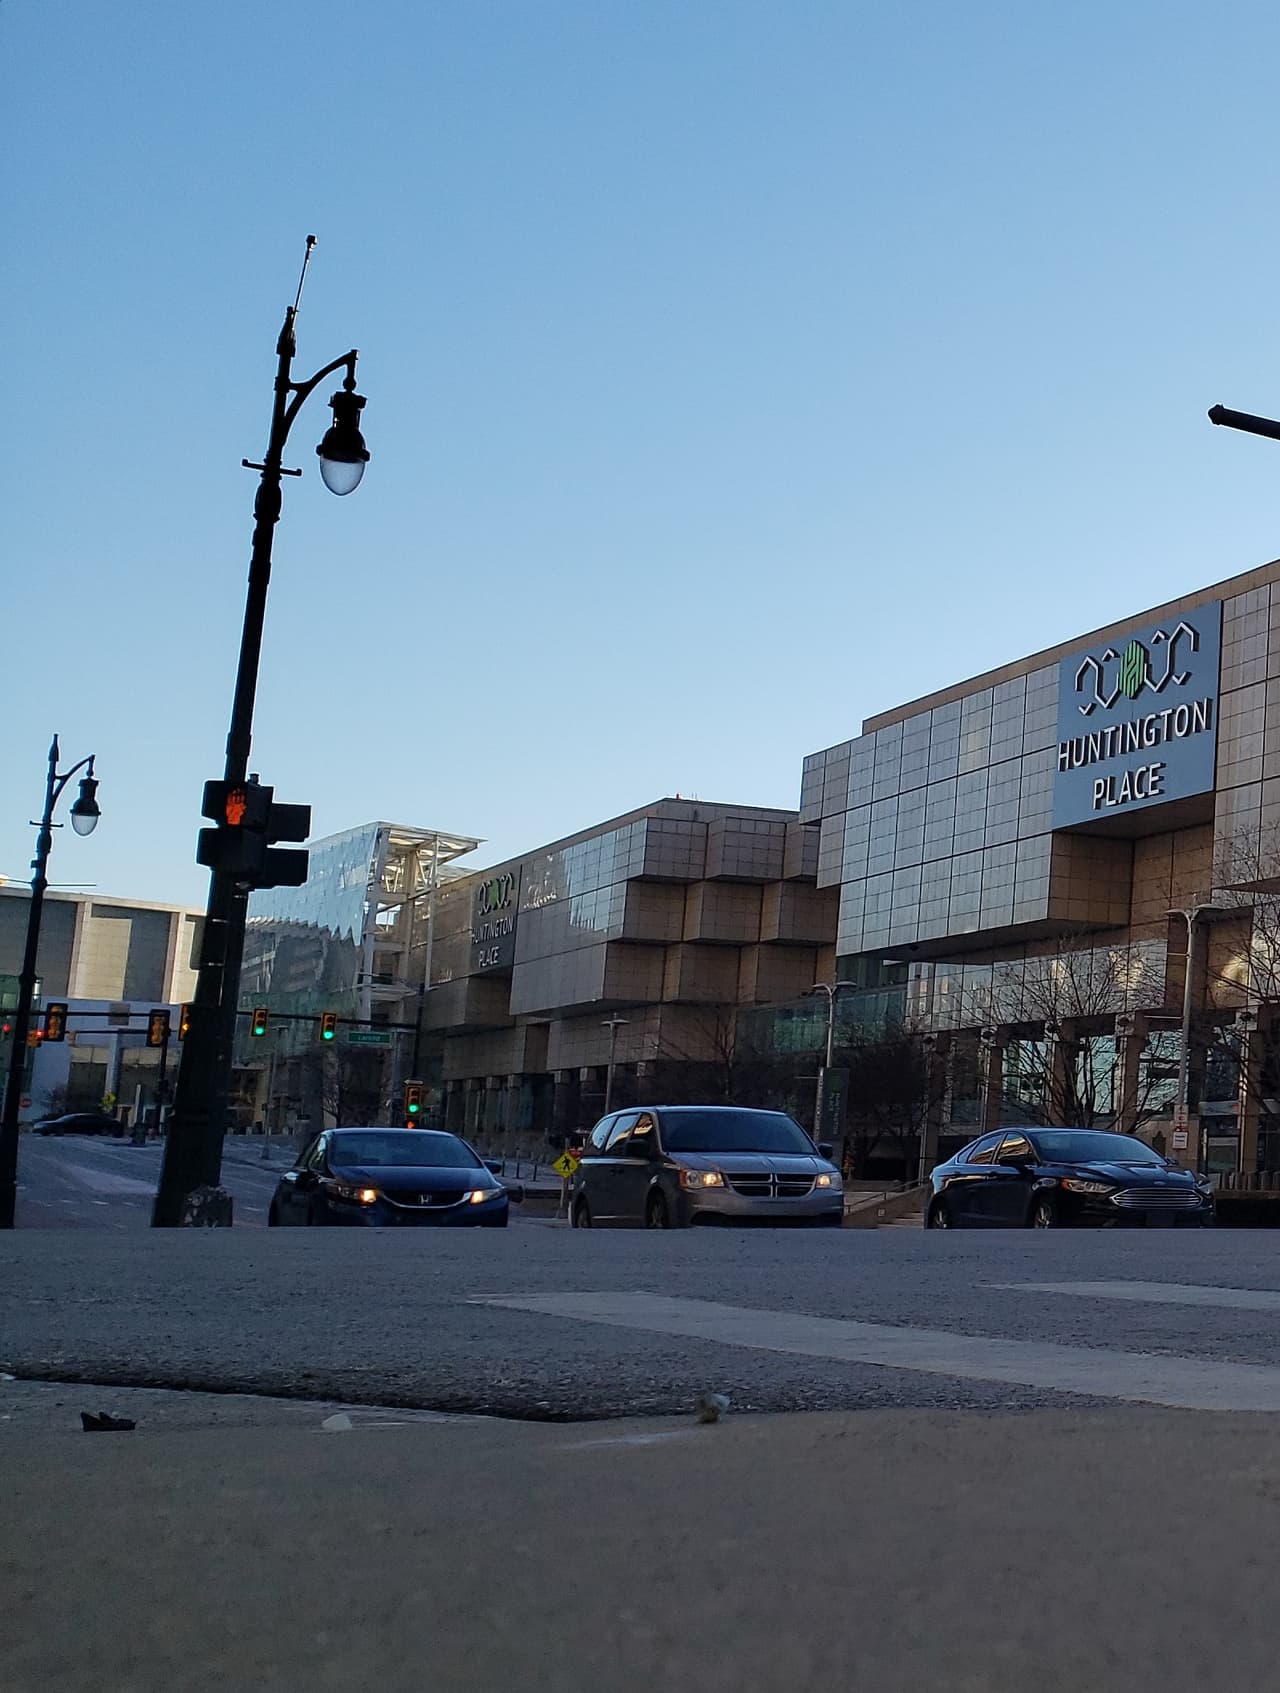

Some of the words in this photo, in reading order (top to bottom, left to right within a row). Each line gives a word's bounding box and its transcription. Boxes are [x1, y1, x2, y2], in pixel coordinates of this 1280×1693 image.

[1057, 697, 1210, 772] HUNTINGTON
[1092, 762, 1164, 810] PLACE
[478, 946, 500, 968] PLACE
